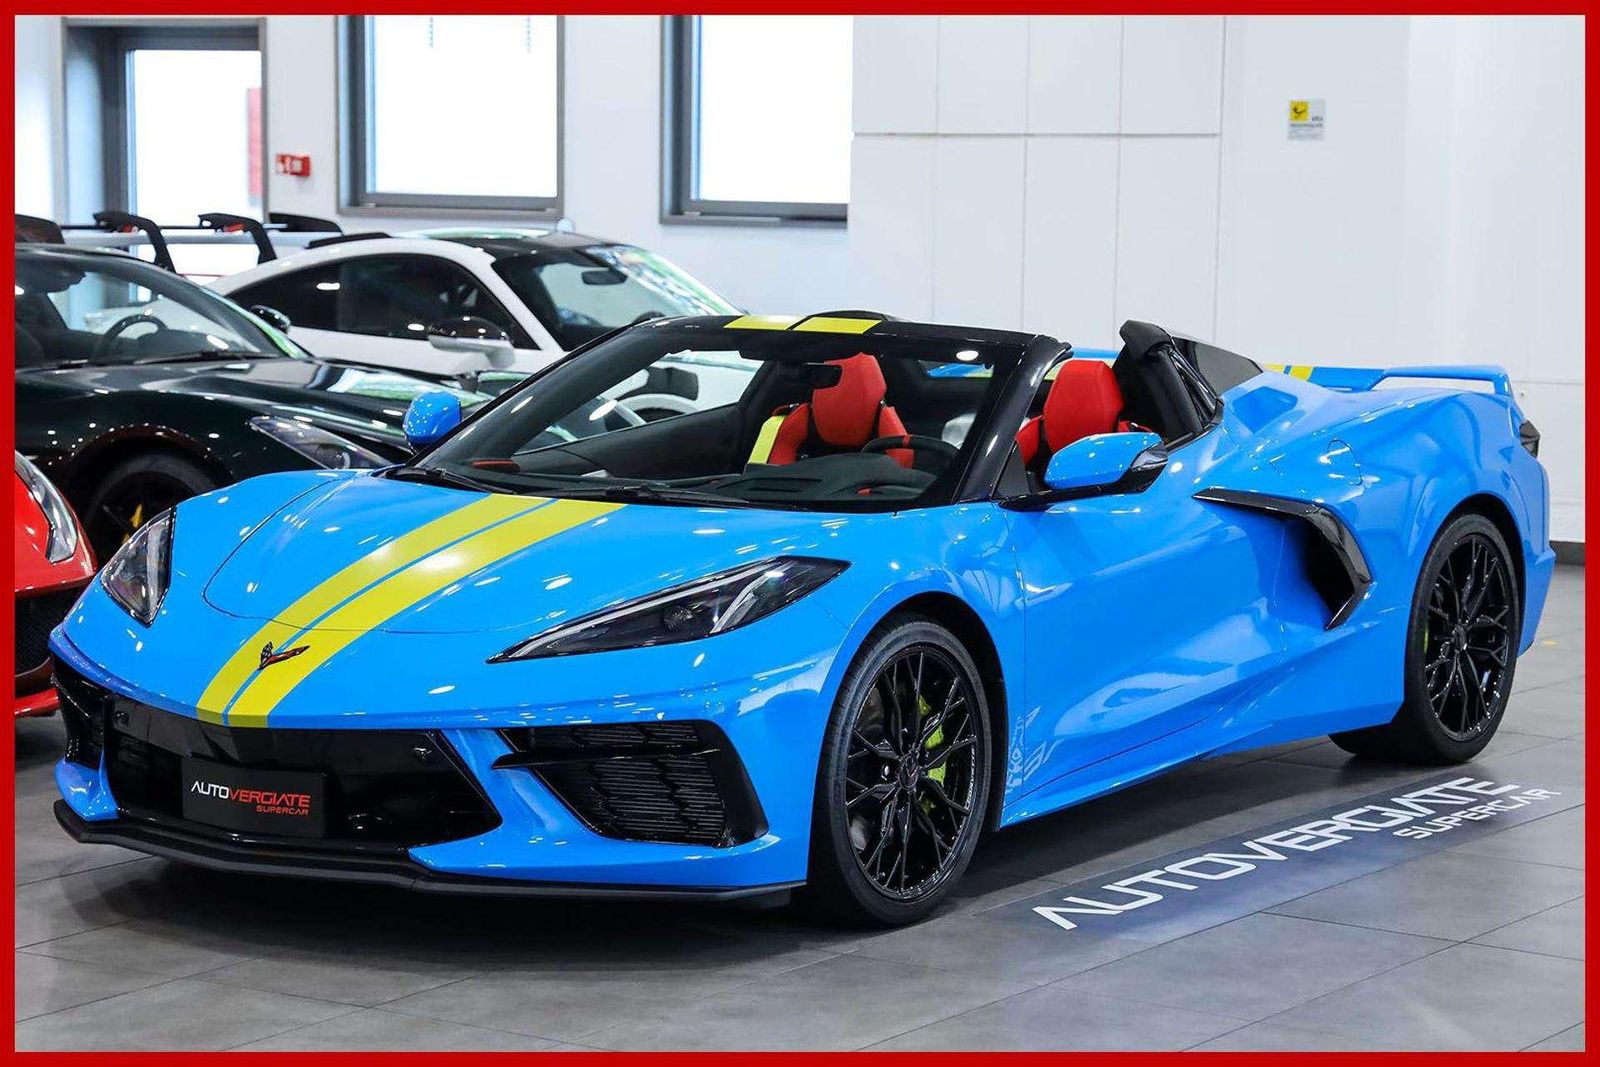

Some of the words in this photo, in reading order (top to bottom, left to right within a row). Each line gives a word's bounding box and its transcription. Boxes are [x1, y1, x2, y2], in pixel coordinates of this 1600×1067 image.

[191, 781, 311, 807] AUTOVERGIATE
[256, 805, 309, 815] SUPERCAR
[1393, 788, 1562, 839] SUPERCAR
[1032, 777, 1520, 930] AUTOVERGIATE
